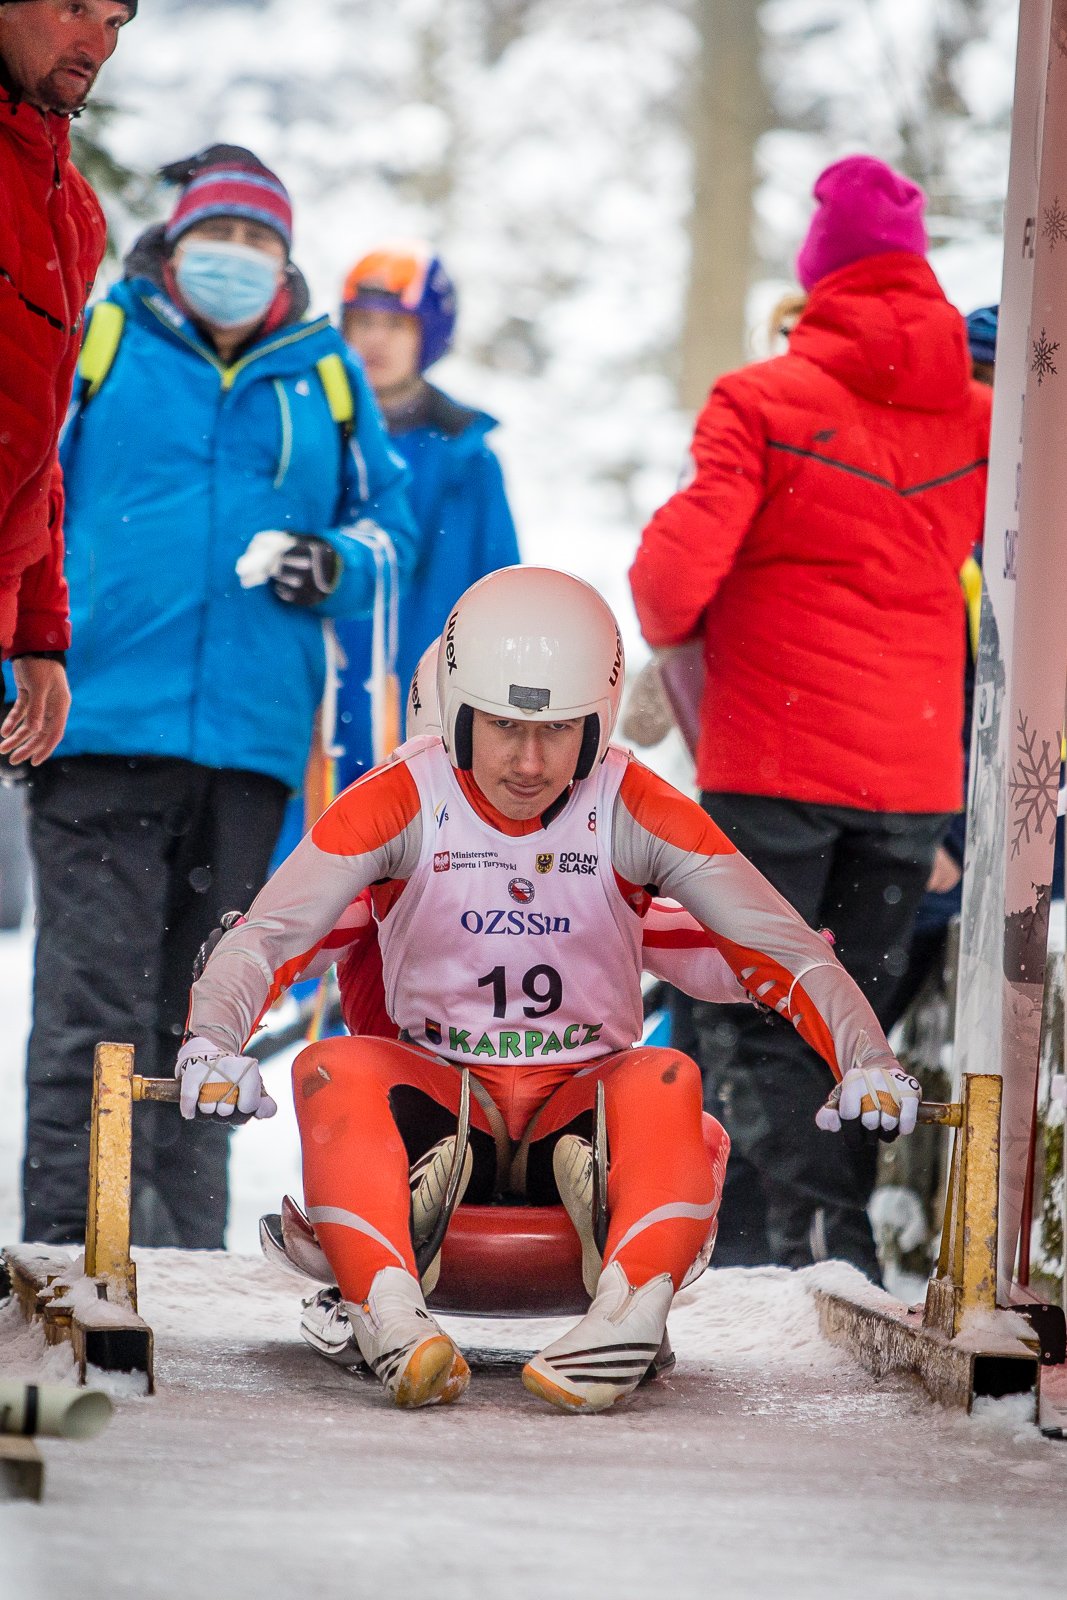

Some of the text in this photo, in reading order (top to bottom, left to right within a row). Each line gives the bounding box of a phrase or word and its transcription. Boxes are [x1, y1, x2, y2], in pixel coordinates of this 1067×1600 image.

[446, 611, 458, 676] uvex
[451, 851, 499, 859] Ministerstwo
[451, 861, 476, 870] Sportu
[482, 861, 517, 871] Turystyki
[560, 852, 598, 866] DOLNY
[478, 964, 562, 1019] 19
[449, 1023, 603, 1058] KARPACZ
